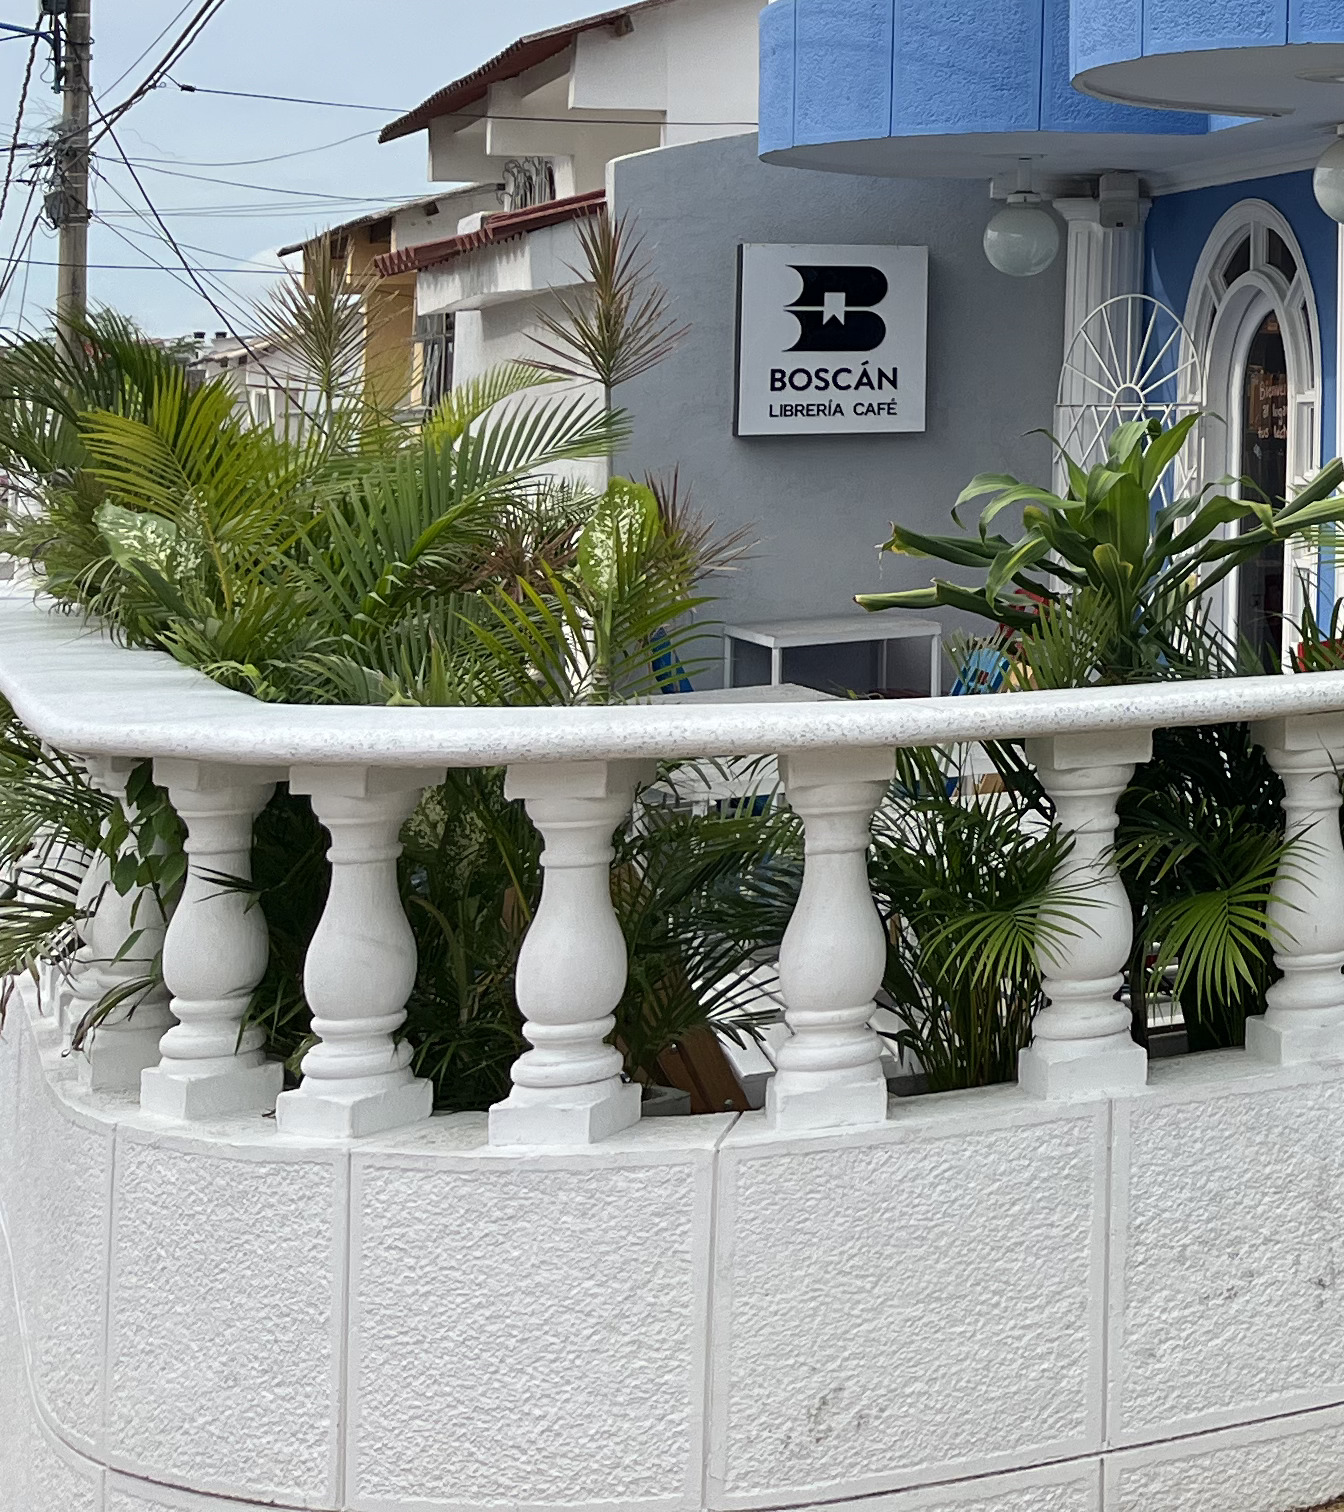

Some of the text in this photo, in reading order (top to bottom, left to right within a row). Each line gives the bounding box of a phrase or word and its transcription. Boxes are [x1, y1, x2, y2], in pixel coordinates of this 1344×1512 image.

[769, 360, 898, 392] BOSCÁN
[769, 398, 898, 418] LIBRERÍA CAFÉ
